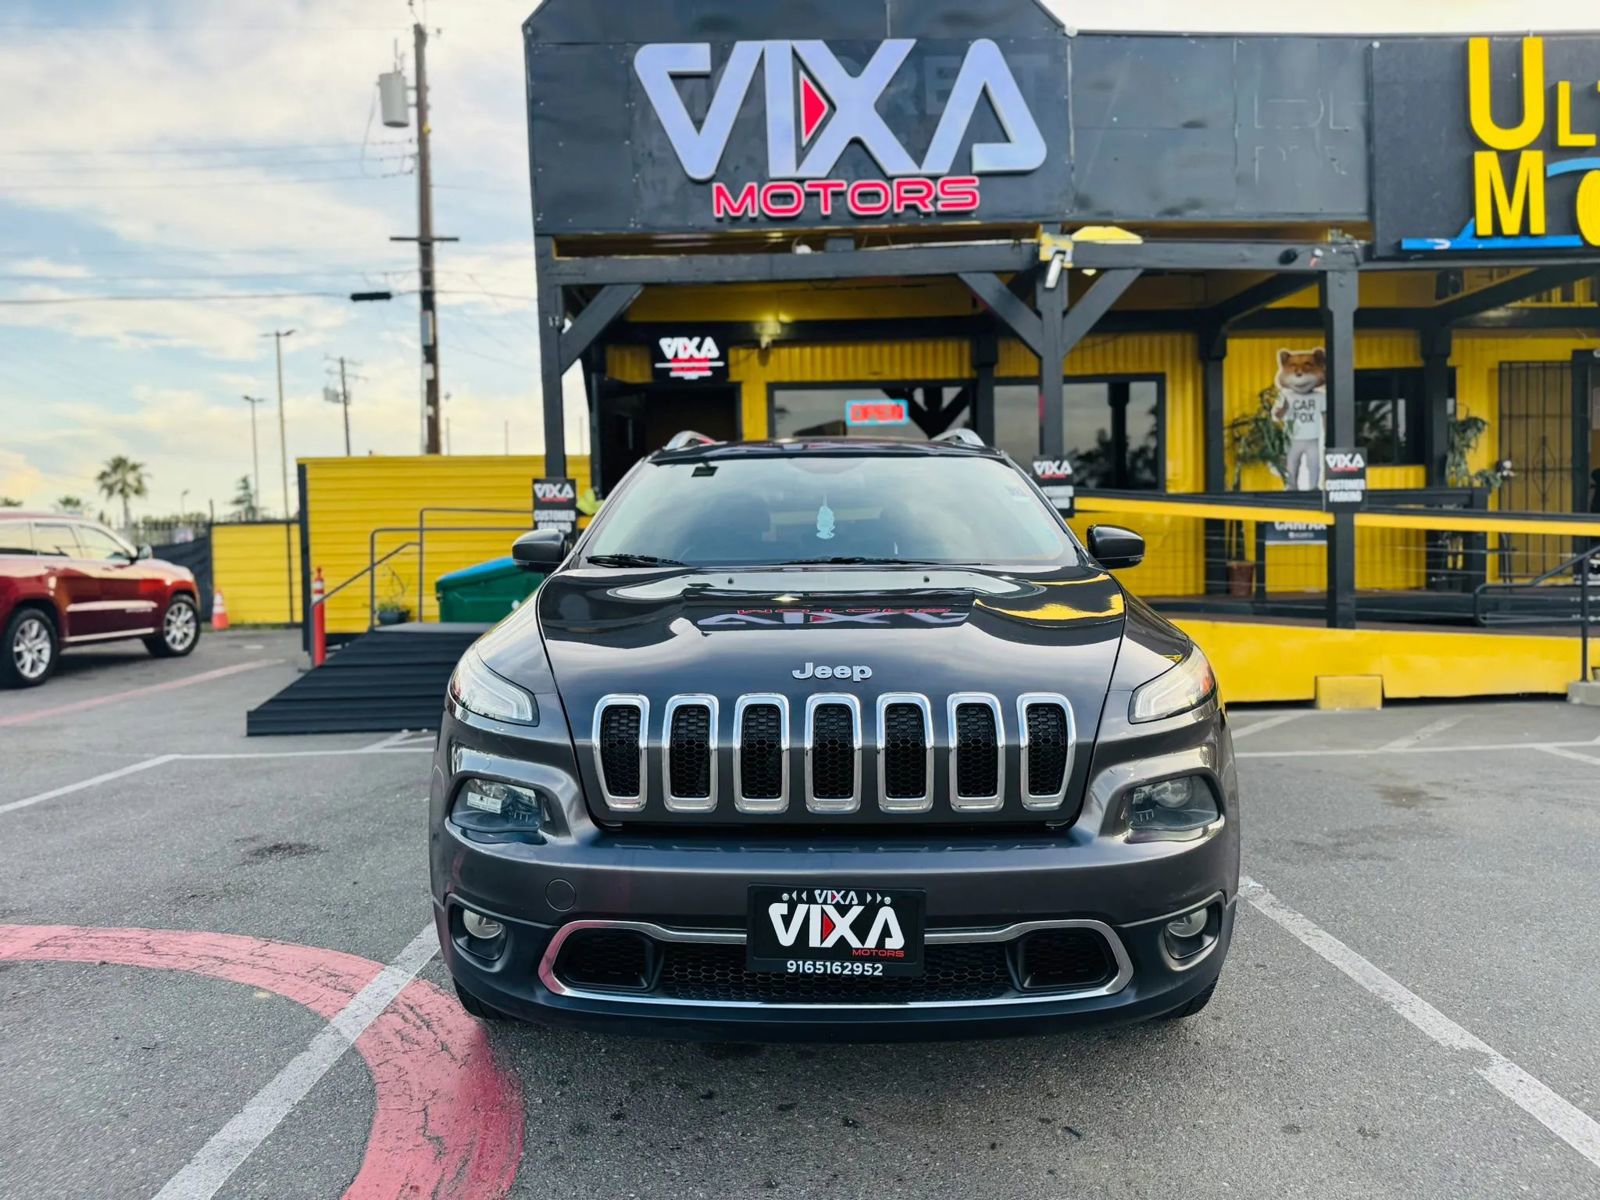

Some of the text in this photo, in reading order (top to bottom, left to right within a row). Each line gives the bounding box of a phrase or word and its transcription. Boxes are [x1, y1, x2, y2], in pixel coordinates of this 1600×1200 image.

[1468, 36, 1600, 150] UL
[634, 38, 1047, 181] VIXA
[712, 176, 980, 218] MOTORS
[659, 336, 719, 360] VIXA
[1293, 400, 1316, 410] CAR
[1293, 412, 1314, 423] FOX
[1033, 460, 1073, 476] VIXA
[1326, 453, 1365, 469] VIXA
[533, 483, 575, 499] VIXA
[792, 662, 873, 682] Jeep
[814, 889, 859, 905] VIXA
[768, 902, 905, 950] VIXA
[852, 949, 905, 958] MOTORS
[787, 960, 883, 976] 9165162952
